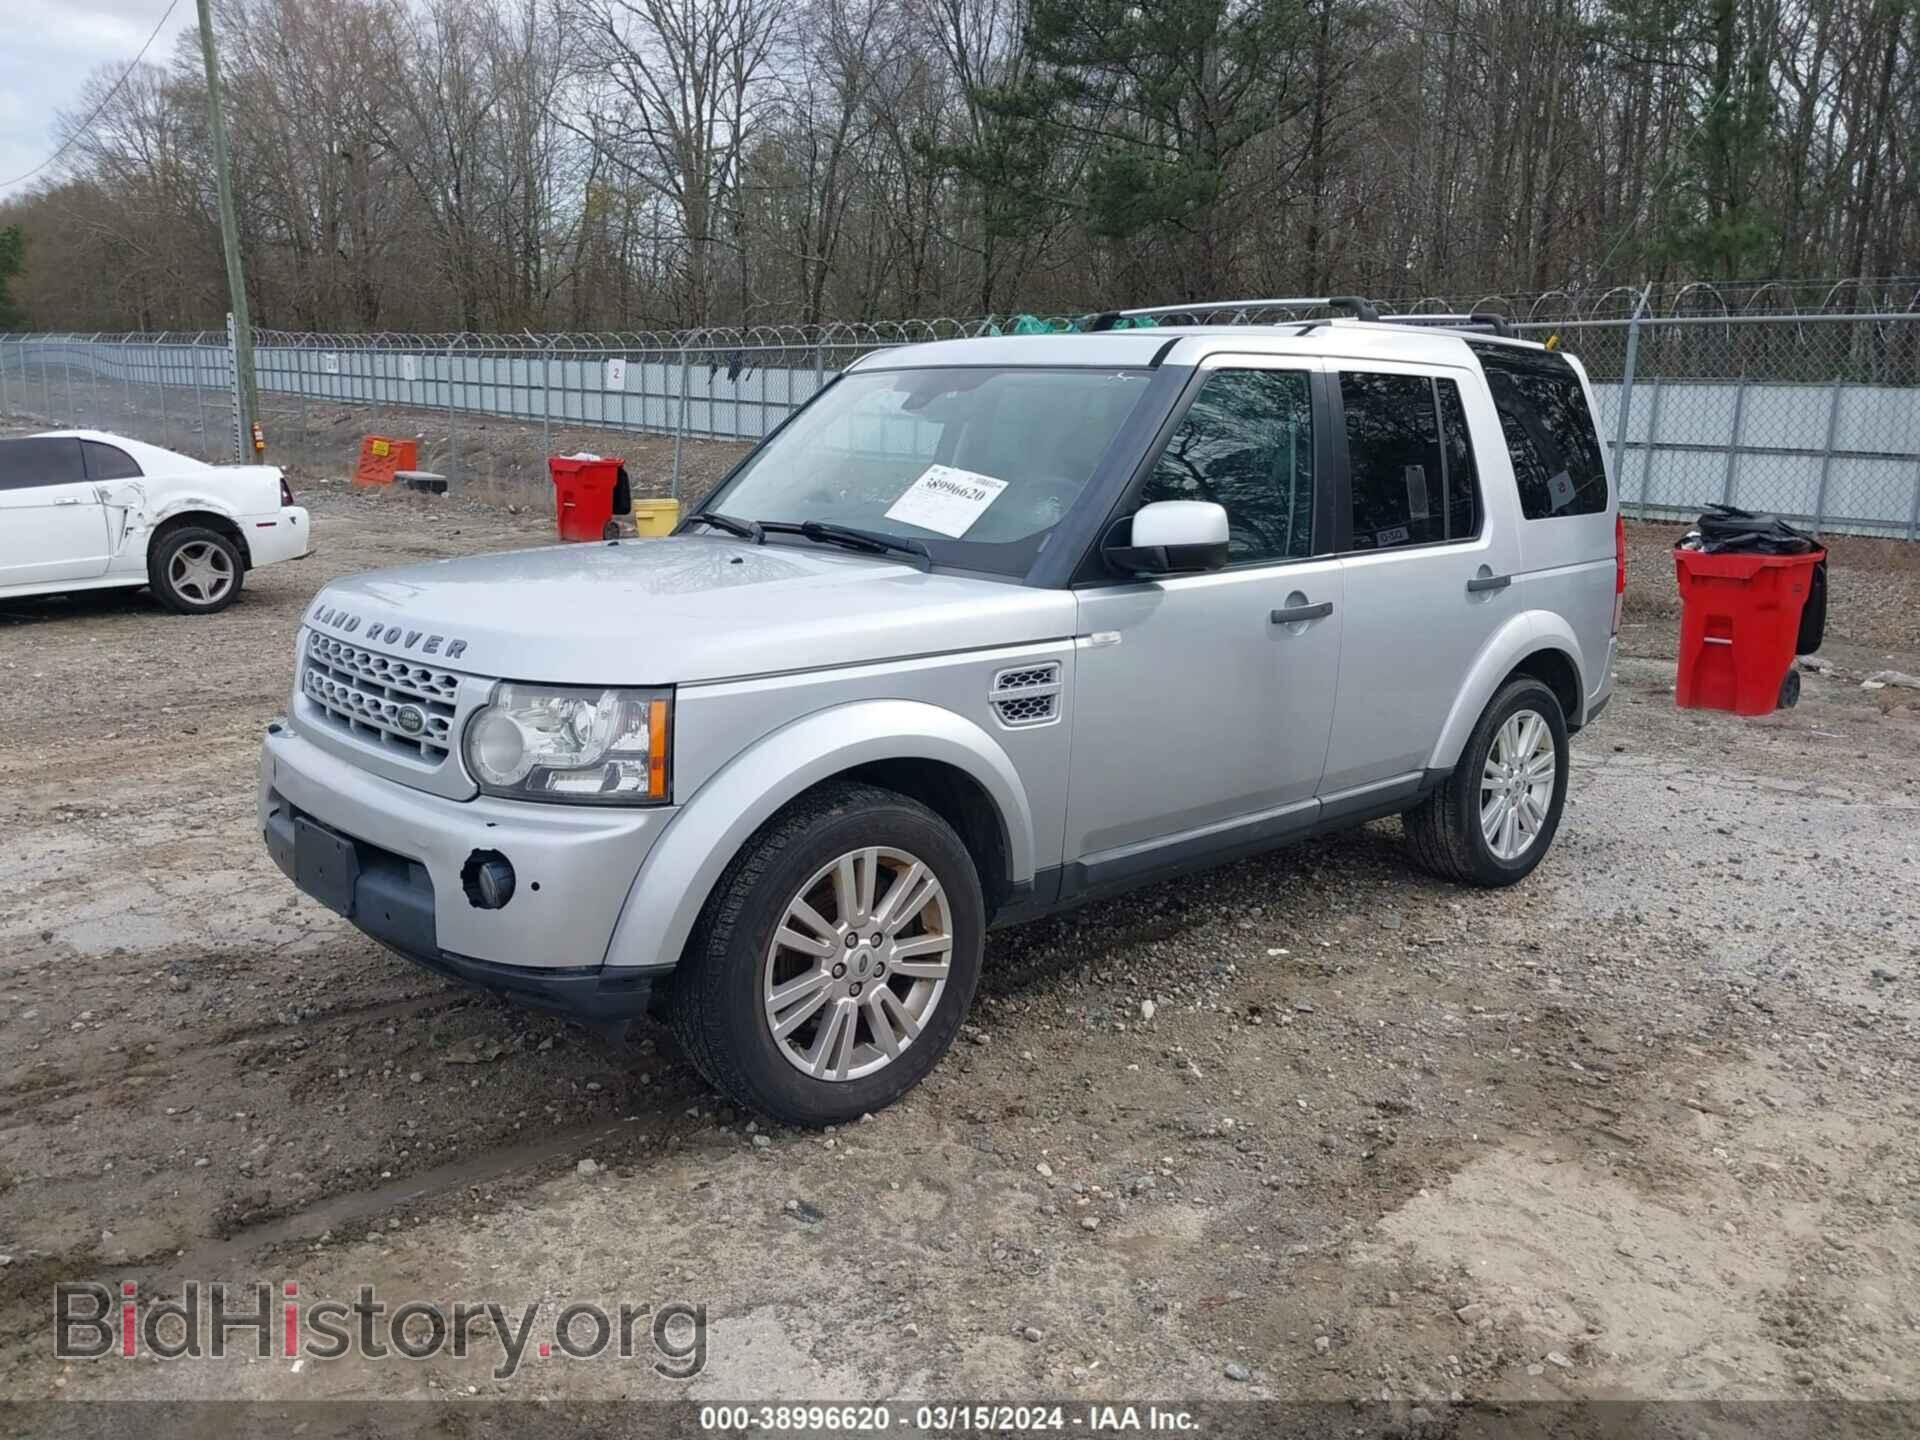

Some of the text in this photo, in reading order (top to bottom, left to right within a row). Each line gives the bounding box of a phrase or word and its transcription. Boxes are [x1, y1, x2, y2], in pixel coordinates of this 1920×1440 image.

[613, 367, 620, 379] 2
[313, 604, 468, 659] LAND ROVER
